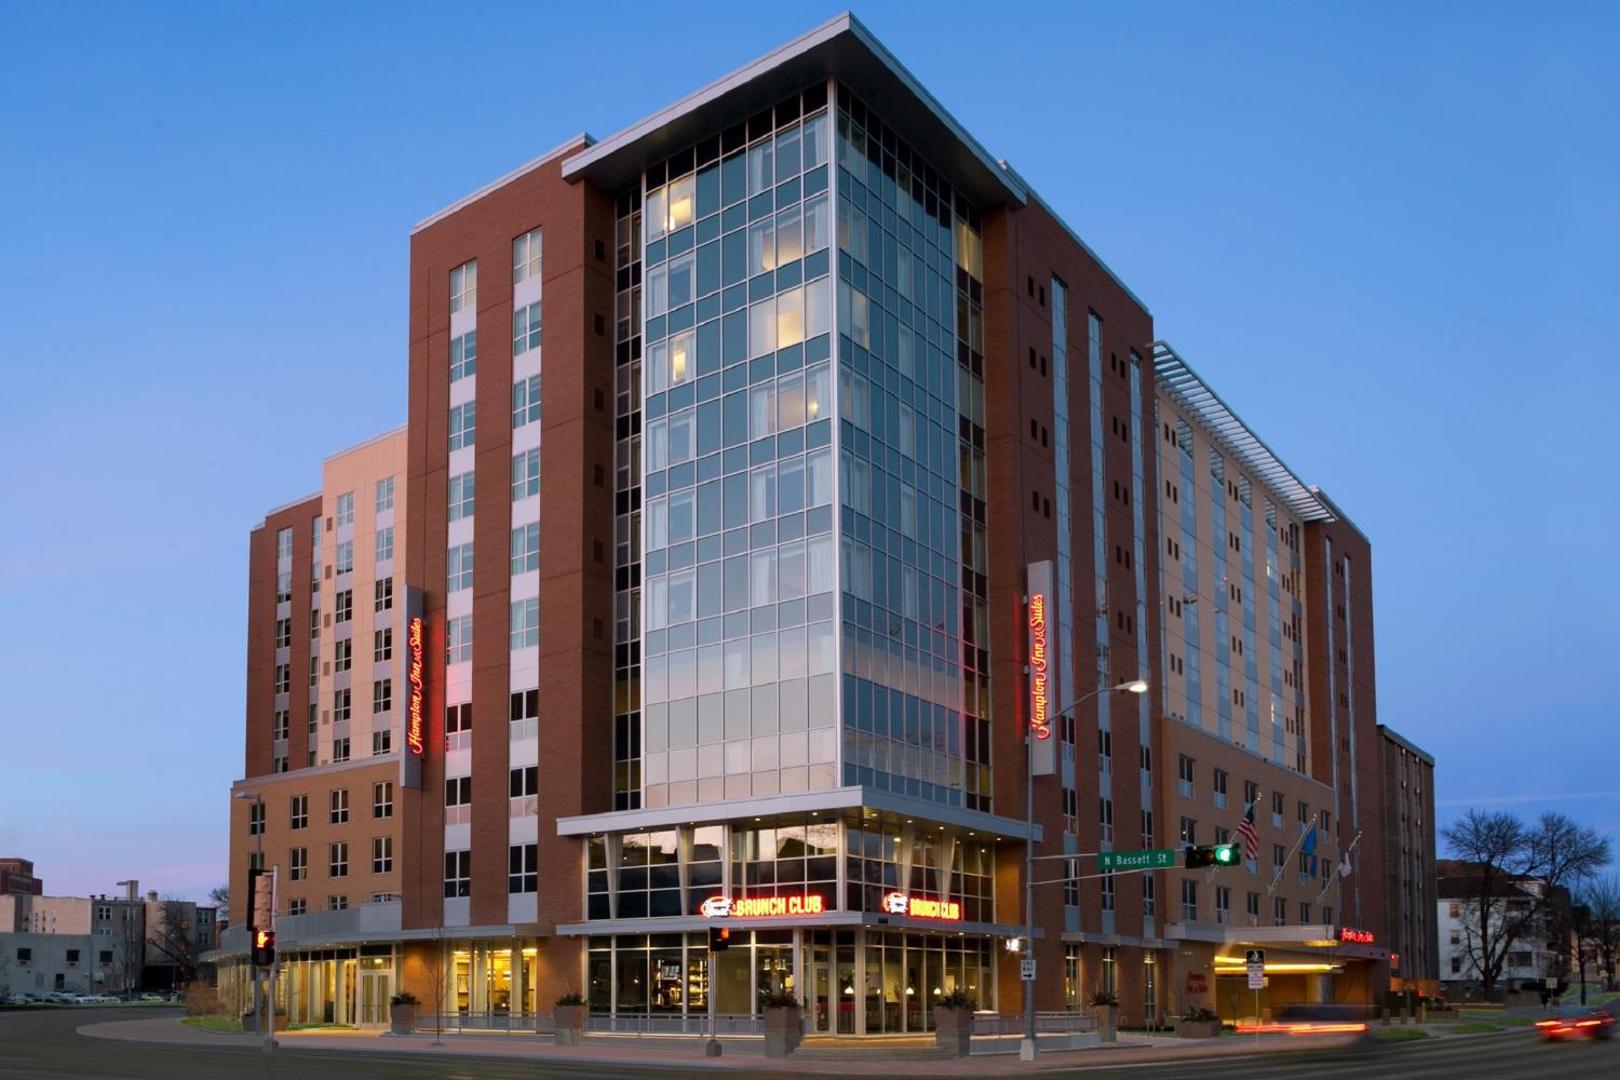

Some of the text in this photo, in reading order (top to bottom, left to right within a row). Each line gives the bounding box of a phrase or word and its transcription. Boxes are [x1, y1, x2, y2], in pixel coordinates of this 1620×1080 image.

[1030, 594, 1043, 630] Suites
[409, 618, 421, 651] Suites
[1030, 636, 1046, 672] Inn
[410, 657, 422, 689] Inn
[408, 690, 423, 754] Hampton
[1031, 673, 1050, 740] Hampton
[1105, 853, 1166, 865] N Bassett St
[736, 897, 786, 916] BRUNCH
[789, 895, 822, 914] CLUB
[910, 898, 940, 918] BRUNCH
[941, 902, 960, 919] CLUB
